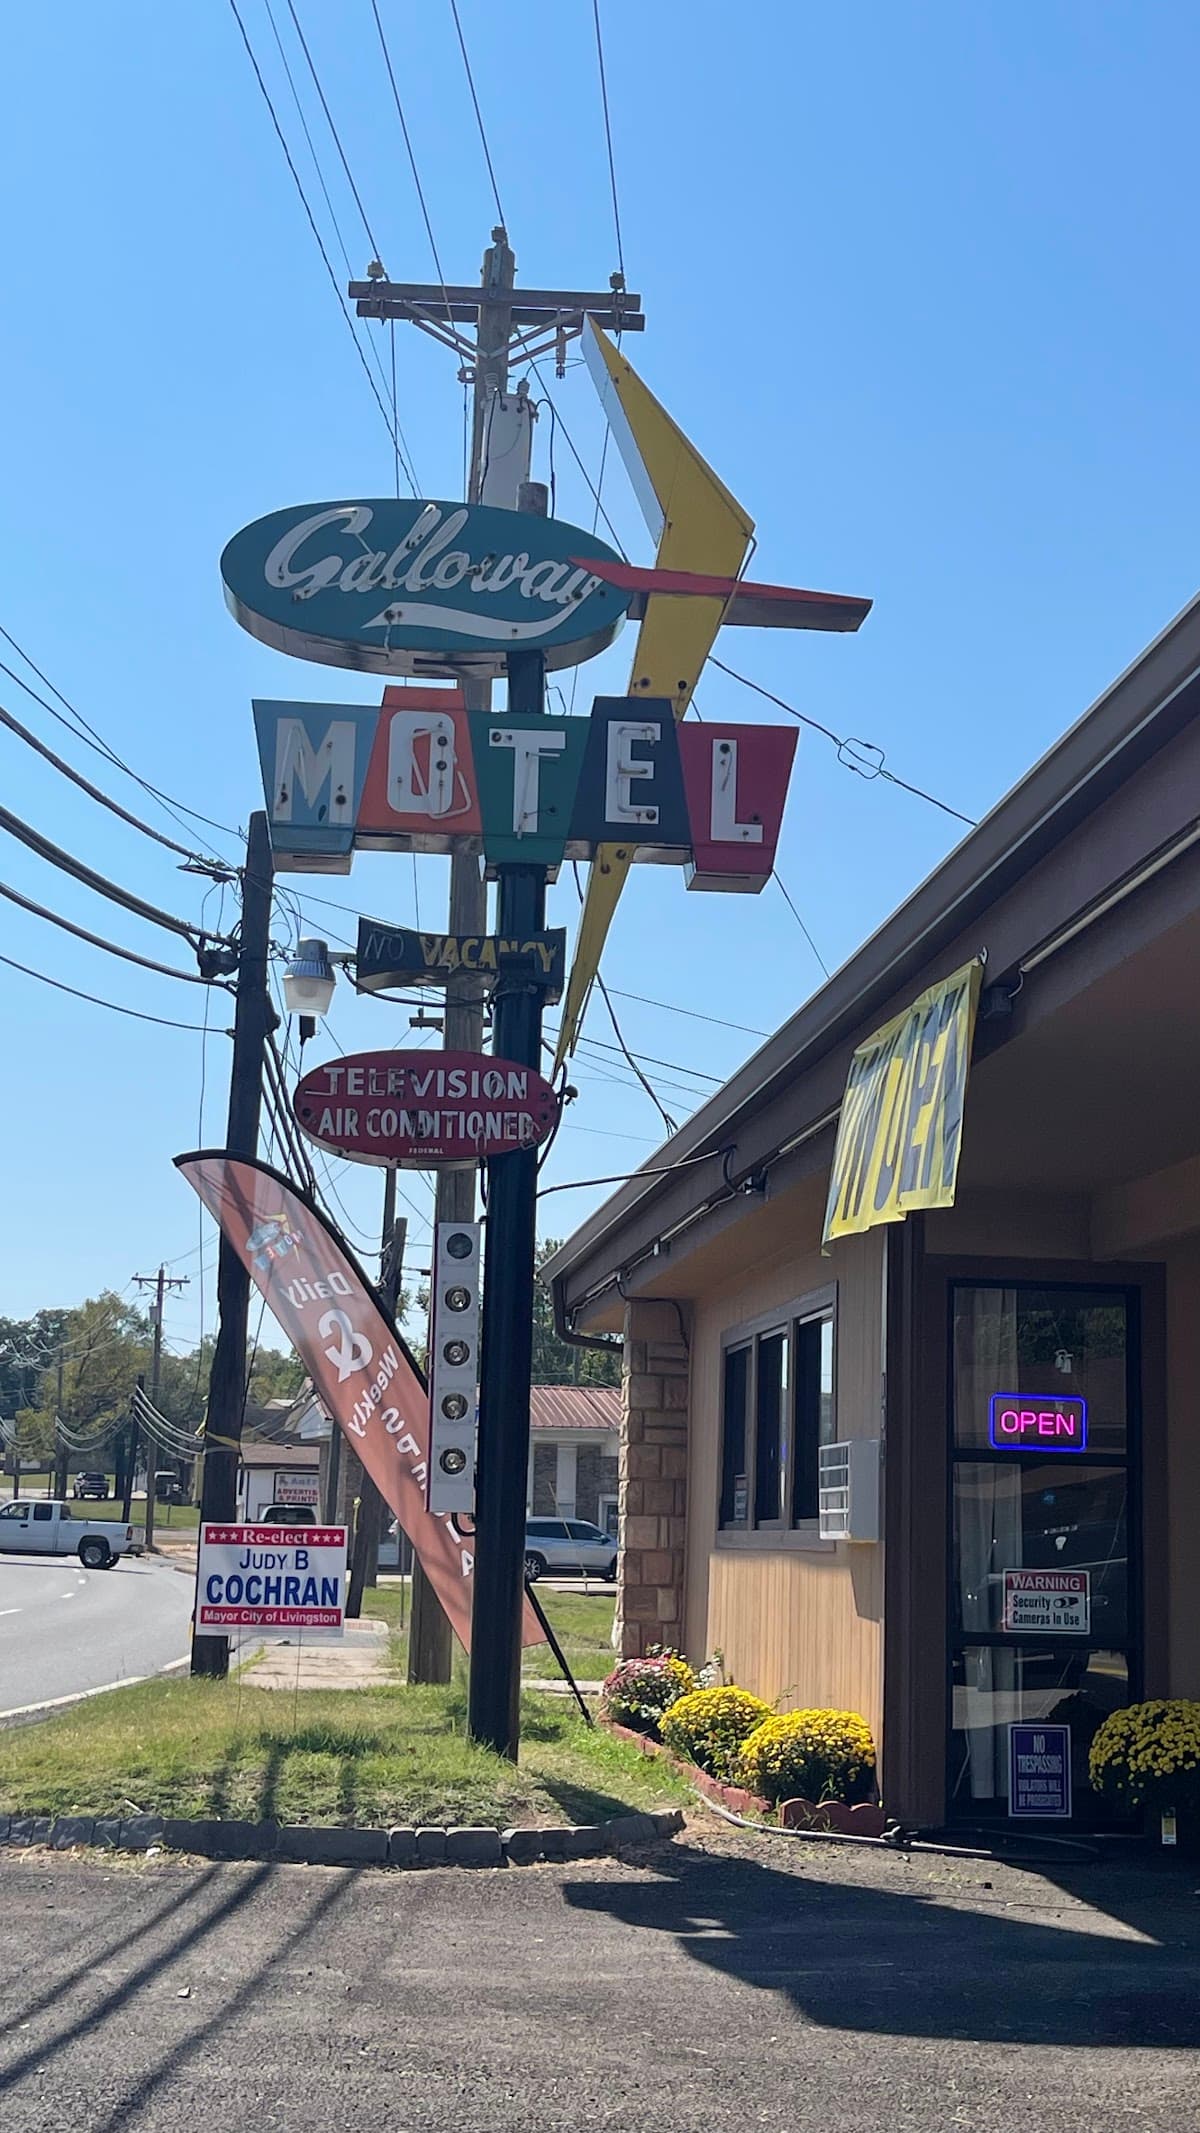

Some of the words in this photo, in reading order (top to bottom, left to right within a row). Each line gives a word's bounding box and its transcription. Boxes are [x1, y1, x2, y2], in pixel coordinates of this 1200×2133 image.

[265, 503, 603, 639] Galloway
[273, 710, 764, 843] MOTEL
[323, 1066, 527, 1100] TELEVISION
[318, 1107, 359, 1136] AIR
[366, 1108, 534, 1141] CONDITIONED
[1000, 1410, 1075, 1436] OPEN
[242, 1529, 308, 1544] Re-elect
[295, 1550, 309, 1570] B
[206, 1574, 338, 1606] COCHRAN
[1012, 1575, 1081, 1590] WARNING
[1013, 1595, 1050, 1611] Security
[204, 1610, 238, 1622] Mayor
[240, 1611, 263, 1624] City
[265, 1611, 278, 1622] of
[279, 1612, 337, 1625] Livingston
[1013, 1611, 1050, 1624] Cameras
[1053, 1612, 1061, 1624] In
[1063, 1612, 1080, 1625] Use
[1033, 1734, 1046, 1754] NO
